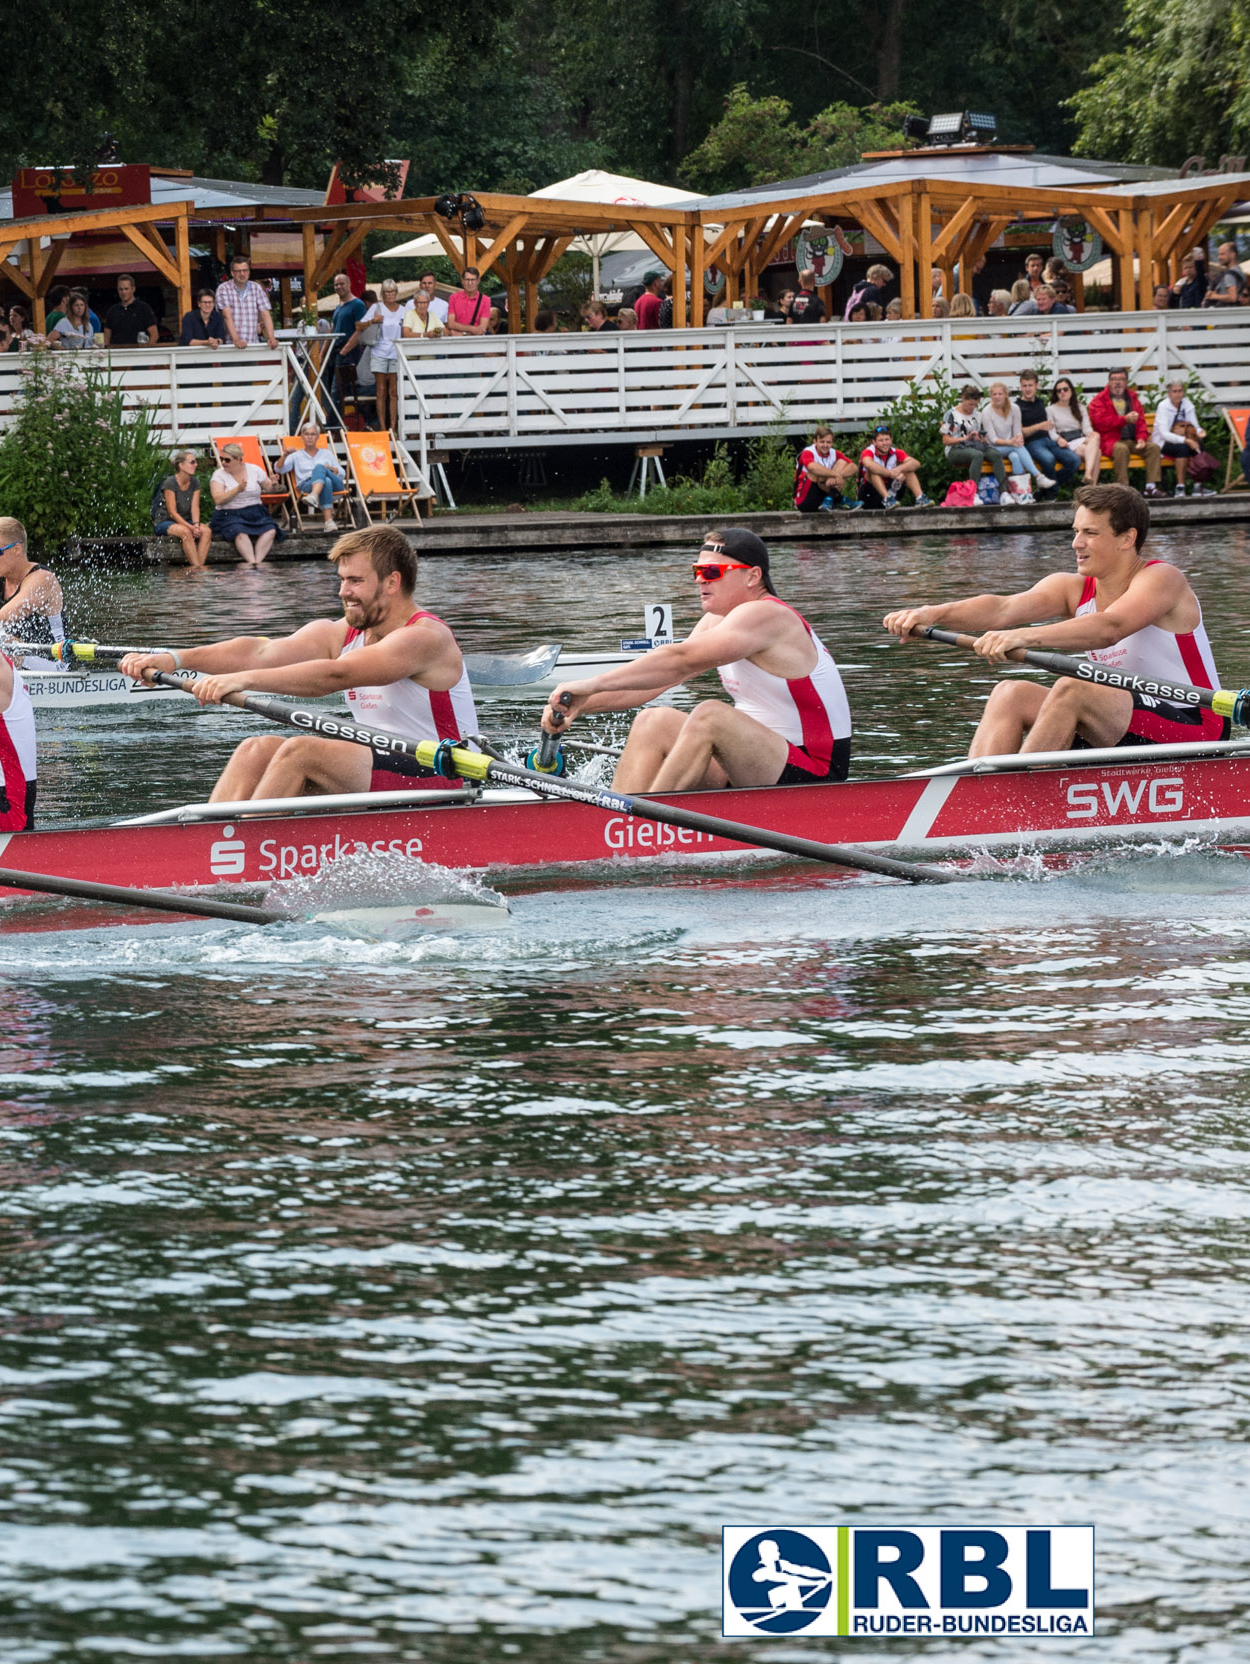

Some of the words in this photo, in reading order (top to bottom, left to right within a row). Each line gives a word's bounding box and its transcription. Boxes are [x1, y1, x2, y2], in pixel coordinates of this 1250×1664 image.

[21, 170, 119, 189] Lozo
[652, 606, 667, 637] 2
[26, 678, 127, 696] ER-BUNDESLIGA
[1076, 663, 1201, 704] Sparkasse
[290, 710, 407, 753] Giessen
[1101, 767, 1152, 777] Stadtwerke
[1066, 777, 1184, 819] SWG
